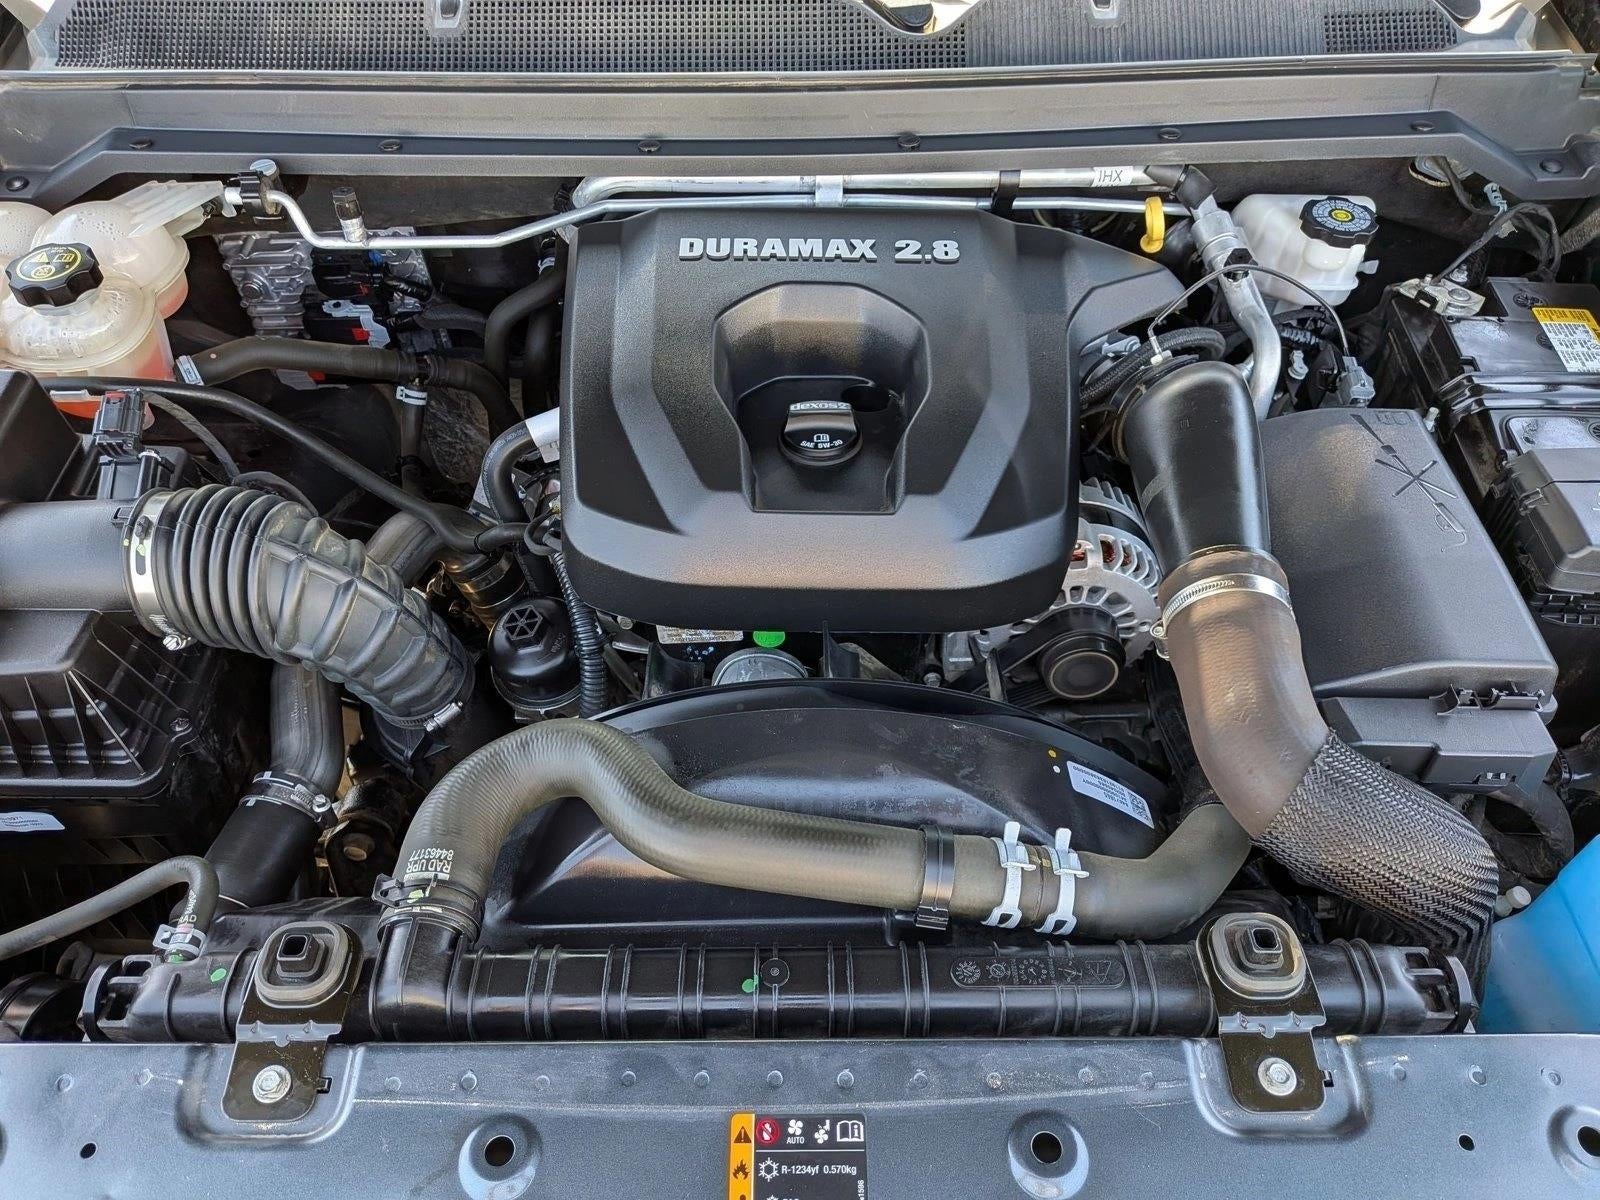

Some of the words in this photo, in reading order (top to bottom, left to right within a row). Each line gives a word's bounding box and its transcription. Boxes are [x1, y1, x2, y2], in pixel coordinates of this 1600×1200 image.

[679, 237, 877, 261] DURAMAX
[894, 239, 960, 262] 2.8
[790, 400, 851, 410] dexos2
[800, 440, 816, 448] SAE
[817, 439, 843, 449] 5W-30
[408, 847, 454, 861] 84463177
[406, 859, 426, 873] UPR
[428, 859, 452, 873] RAD
[786, 1136, 805, 1144] AUTO
[781, 1165, 819, 1175] R-1234yf
[823, 1165, 857, 1175] 0.570kg
